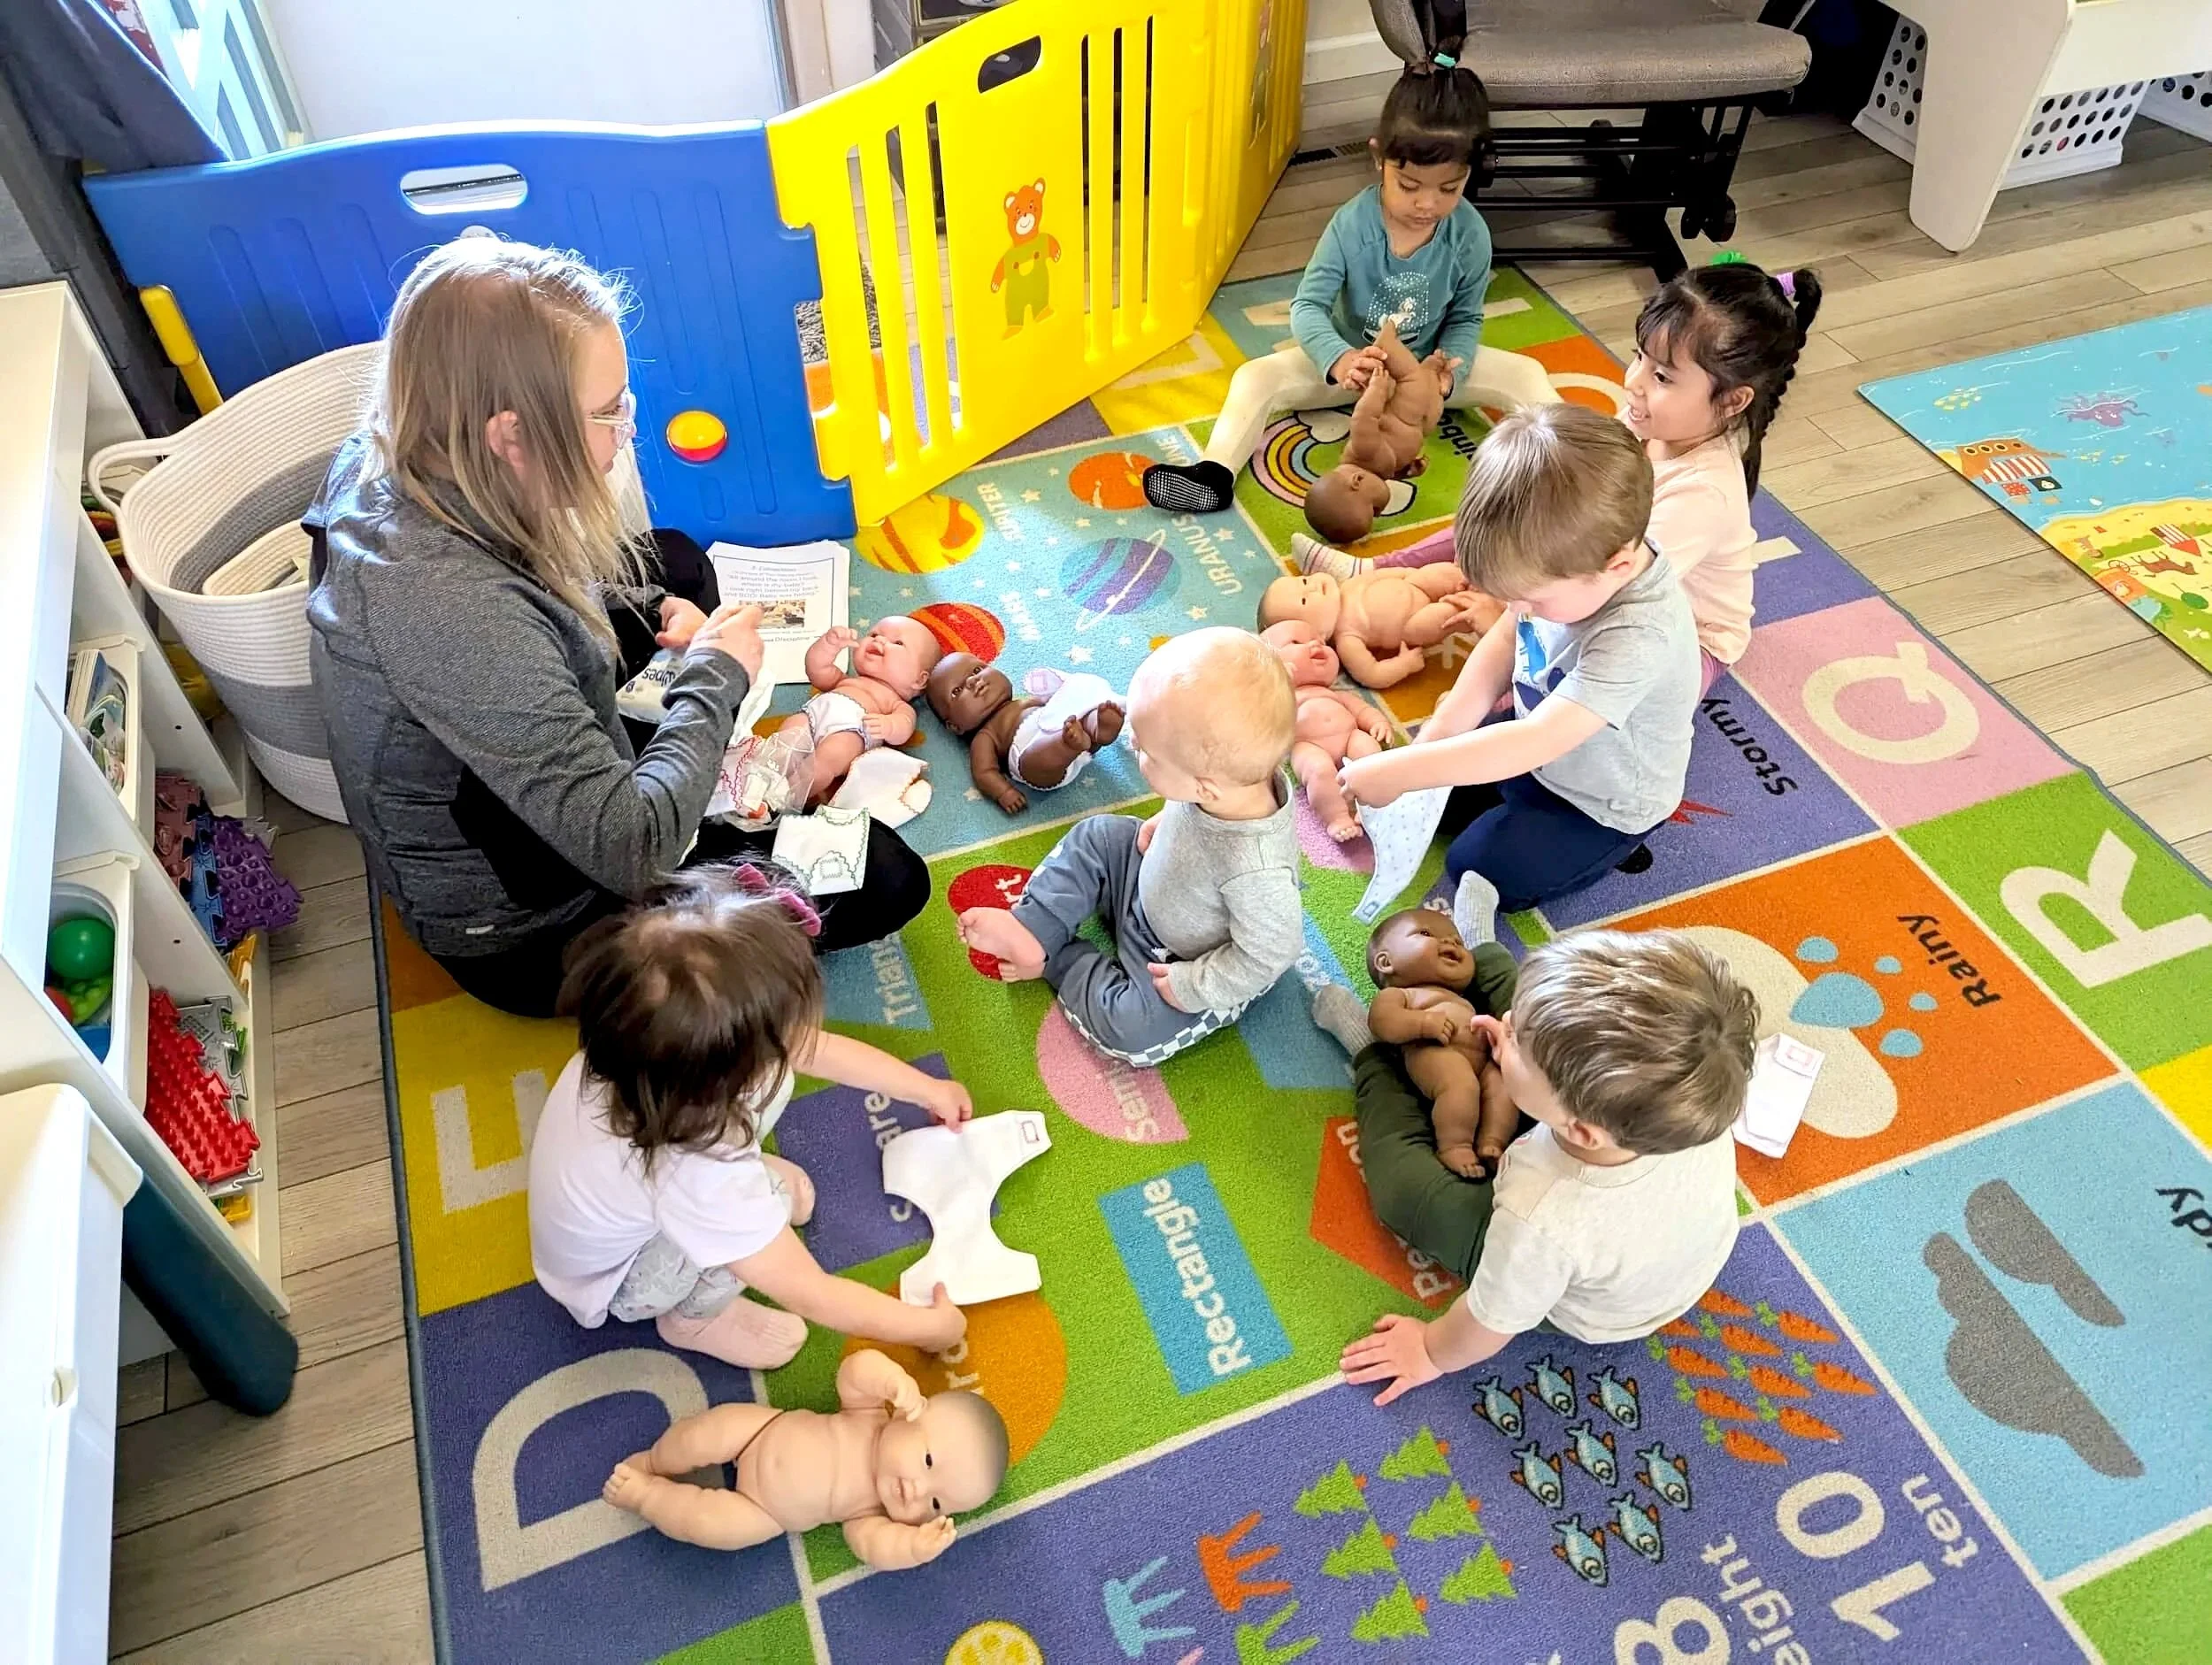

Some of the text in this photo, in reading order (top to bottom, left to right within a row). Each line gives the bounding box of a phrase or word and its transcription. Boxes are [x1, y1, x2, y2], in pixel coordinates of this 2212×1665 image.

[977, 482, 1026, 541] JUPITER
[1171, 514, 1244, 597] URANUS
[1000, 591, 1041, 641] MARS
[1701, 696, 1798, 797] Stormy
[1802, 641, 1980, 764] Q
[2000, 829, 2212, 989] R
[1897, 914, 2002, 1009] Rainy
[1142, 1178, 1254, 1377] Rectangle
[1776, 1470, 1936, 1641] 10
[1901, 1474, 1978, 1568] ten
[1700, 1533, 1811, 1665] eight
